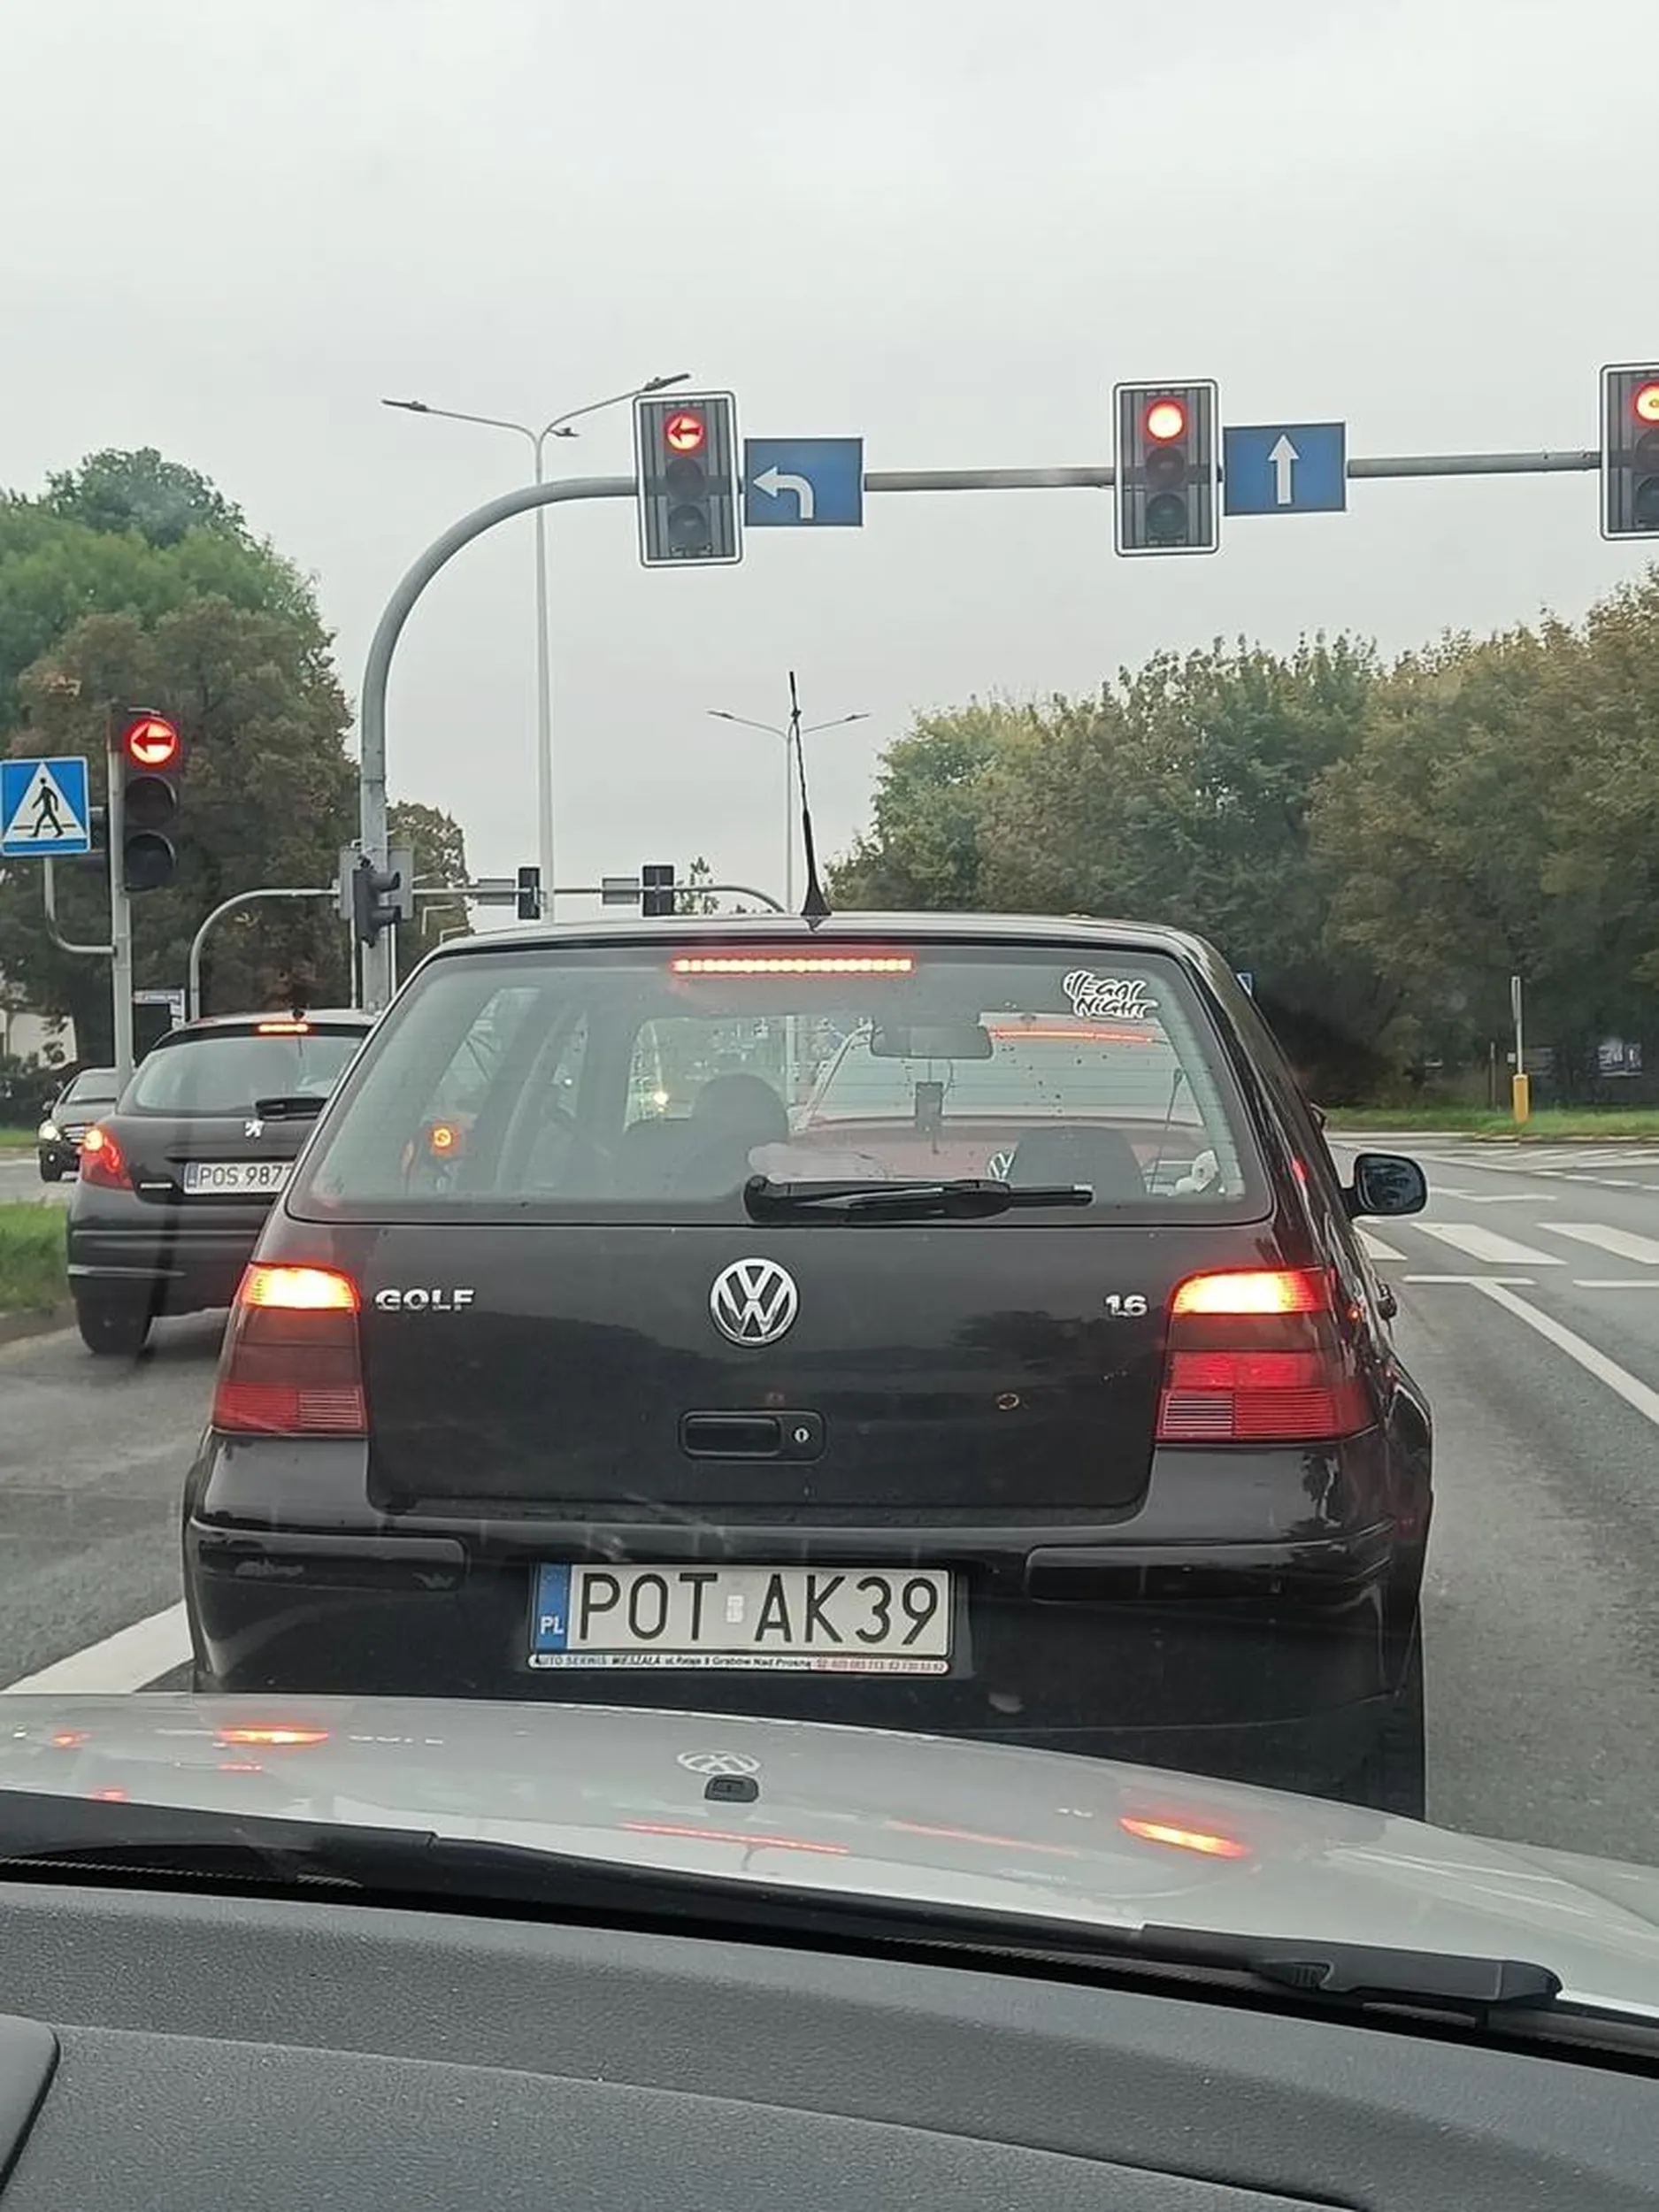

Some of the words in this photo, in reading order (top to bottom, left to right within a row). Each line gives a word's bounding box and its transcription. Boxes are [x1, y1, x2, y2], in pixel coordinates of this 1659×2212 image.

[199, 1166, 239, 1187] POS
[375, 1289, 474, 1311] GOLF
[580, 1571, 718, 1640] POT
[753, 1573, 938, 1645] AK39
[541, 1616, 565, 1634] PL
